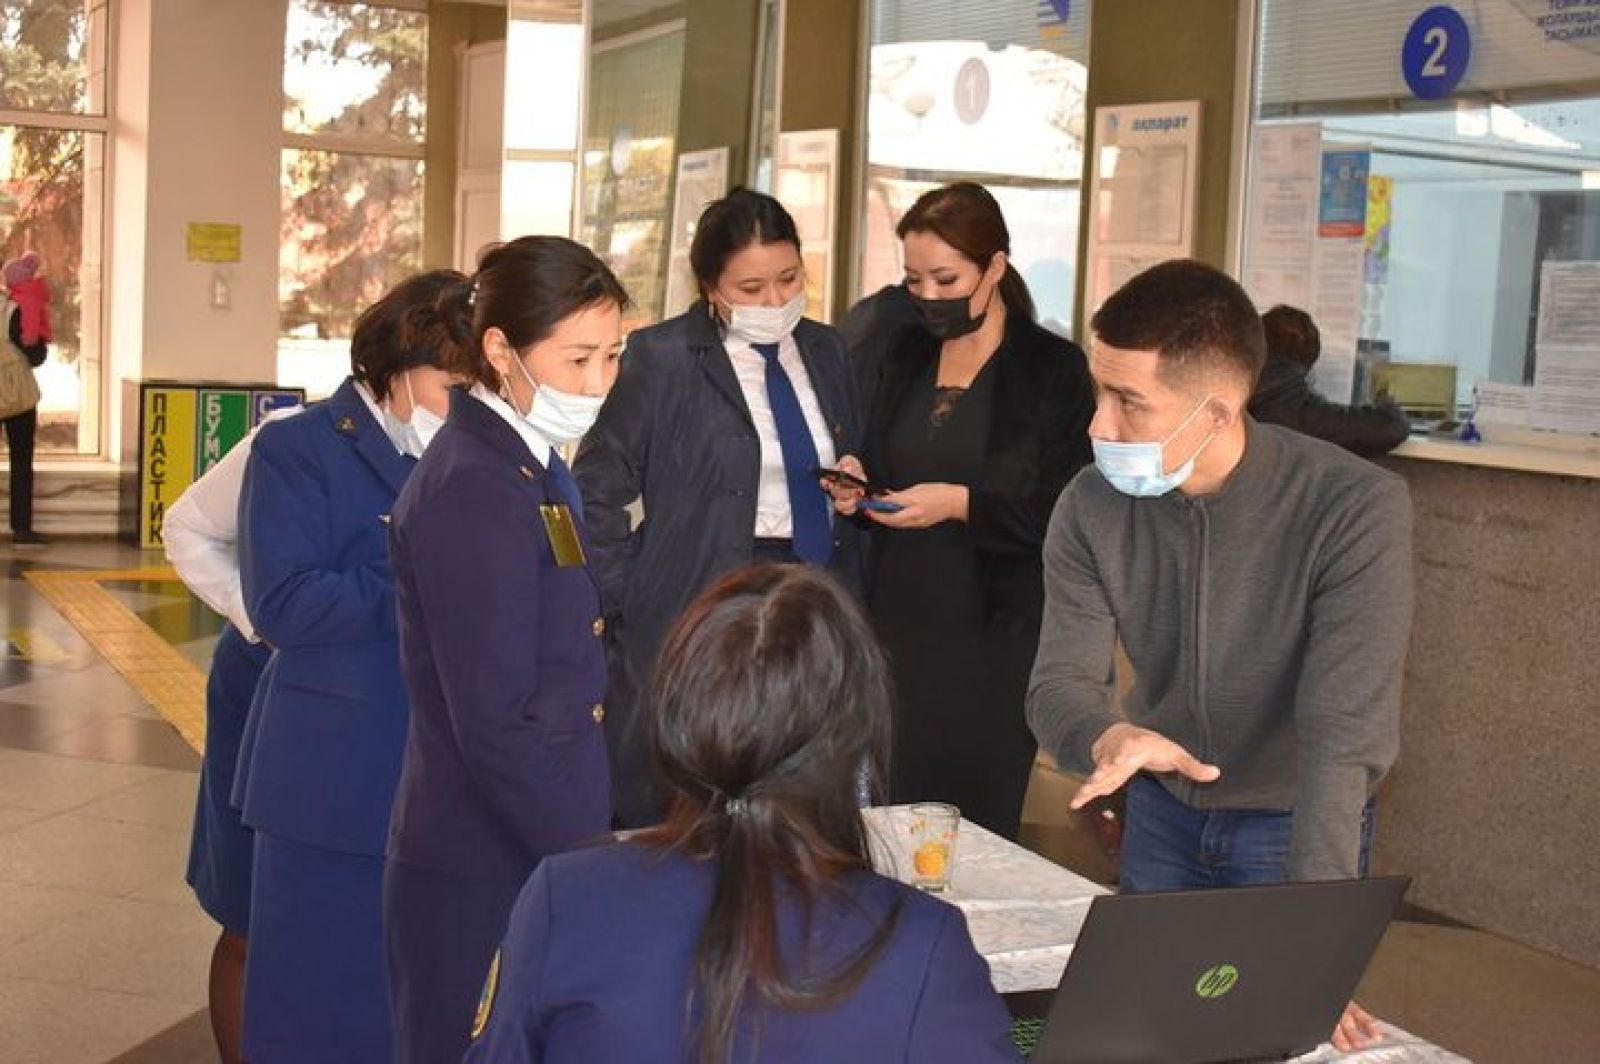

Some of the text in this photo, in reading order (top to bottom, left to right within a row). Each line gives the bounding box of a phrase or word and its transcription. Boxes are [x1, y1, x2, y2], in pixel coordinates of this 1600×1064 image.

[1421, 28, 1449, 77] 2
[149, 393, 167, 544] ПЛАСТИК
[1196, 965, 1238, 997] hp
